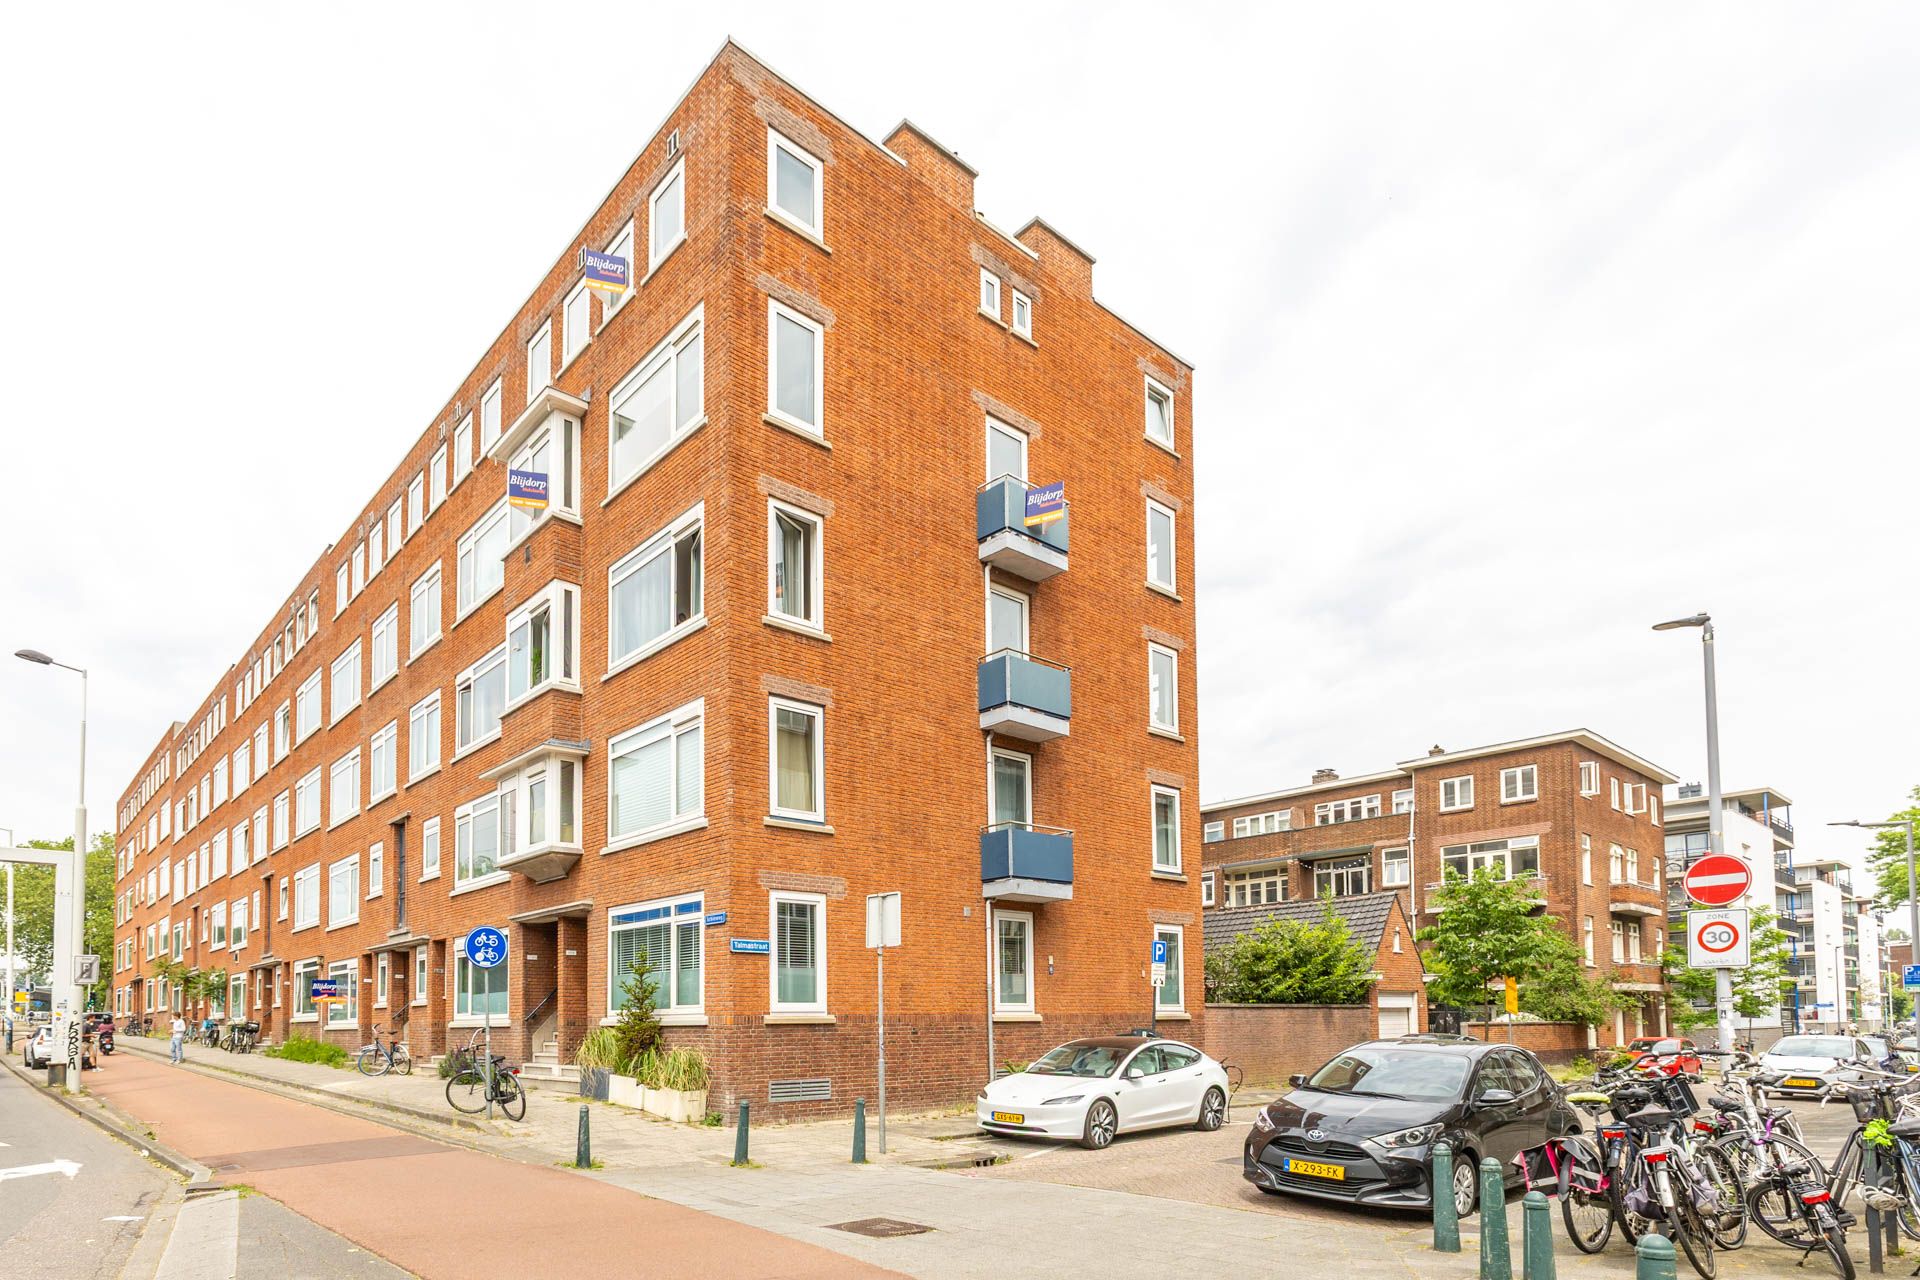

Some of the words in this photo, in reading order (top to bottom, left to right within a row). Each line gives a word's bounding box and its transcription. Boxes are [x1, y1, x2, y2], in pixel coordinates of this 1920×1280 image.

[586, 256, 625, 274] Blijdorp
[510, 475, 547, 490] Blijdorp
[1027, 490, 1063, 505] Blijdorp
[1706, 931, 1731, 943] 30
[734, 941, 769, 950] Talmastraat
[1156, 944, 1163, 961] P
[1905, 967, 1913, 975] P
[1294, 1162, 1338, 1177] X-293-FK
